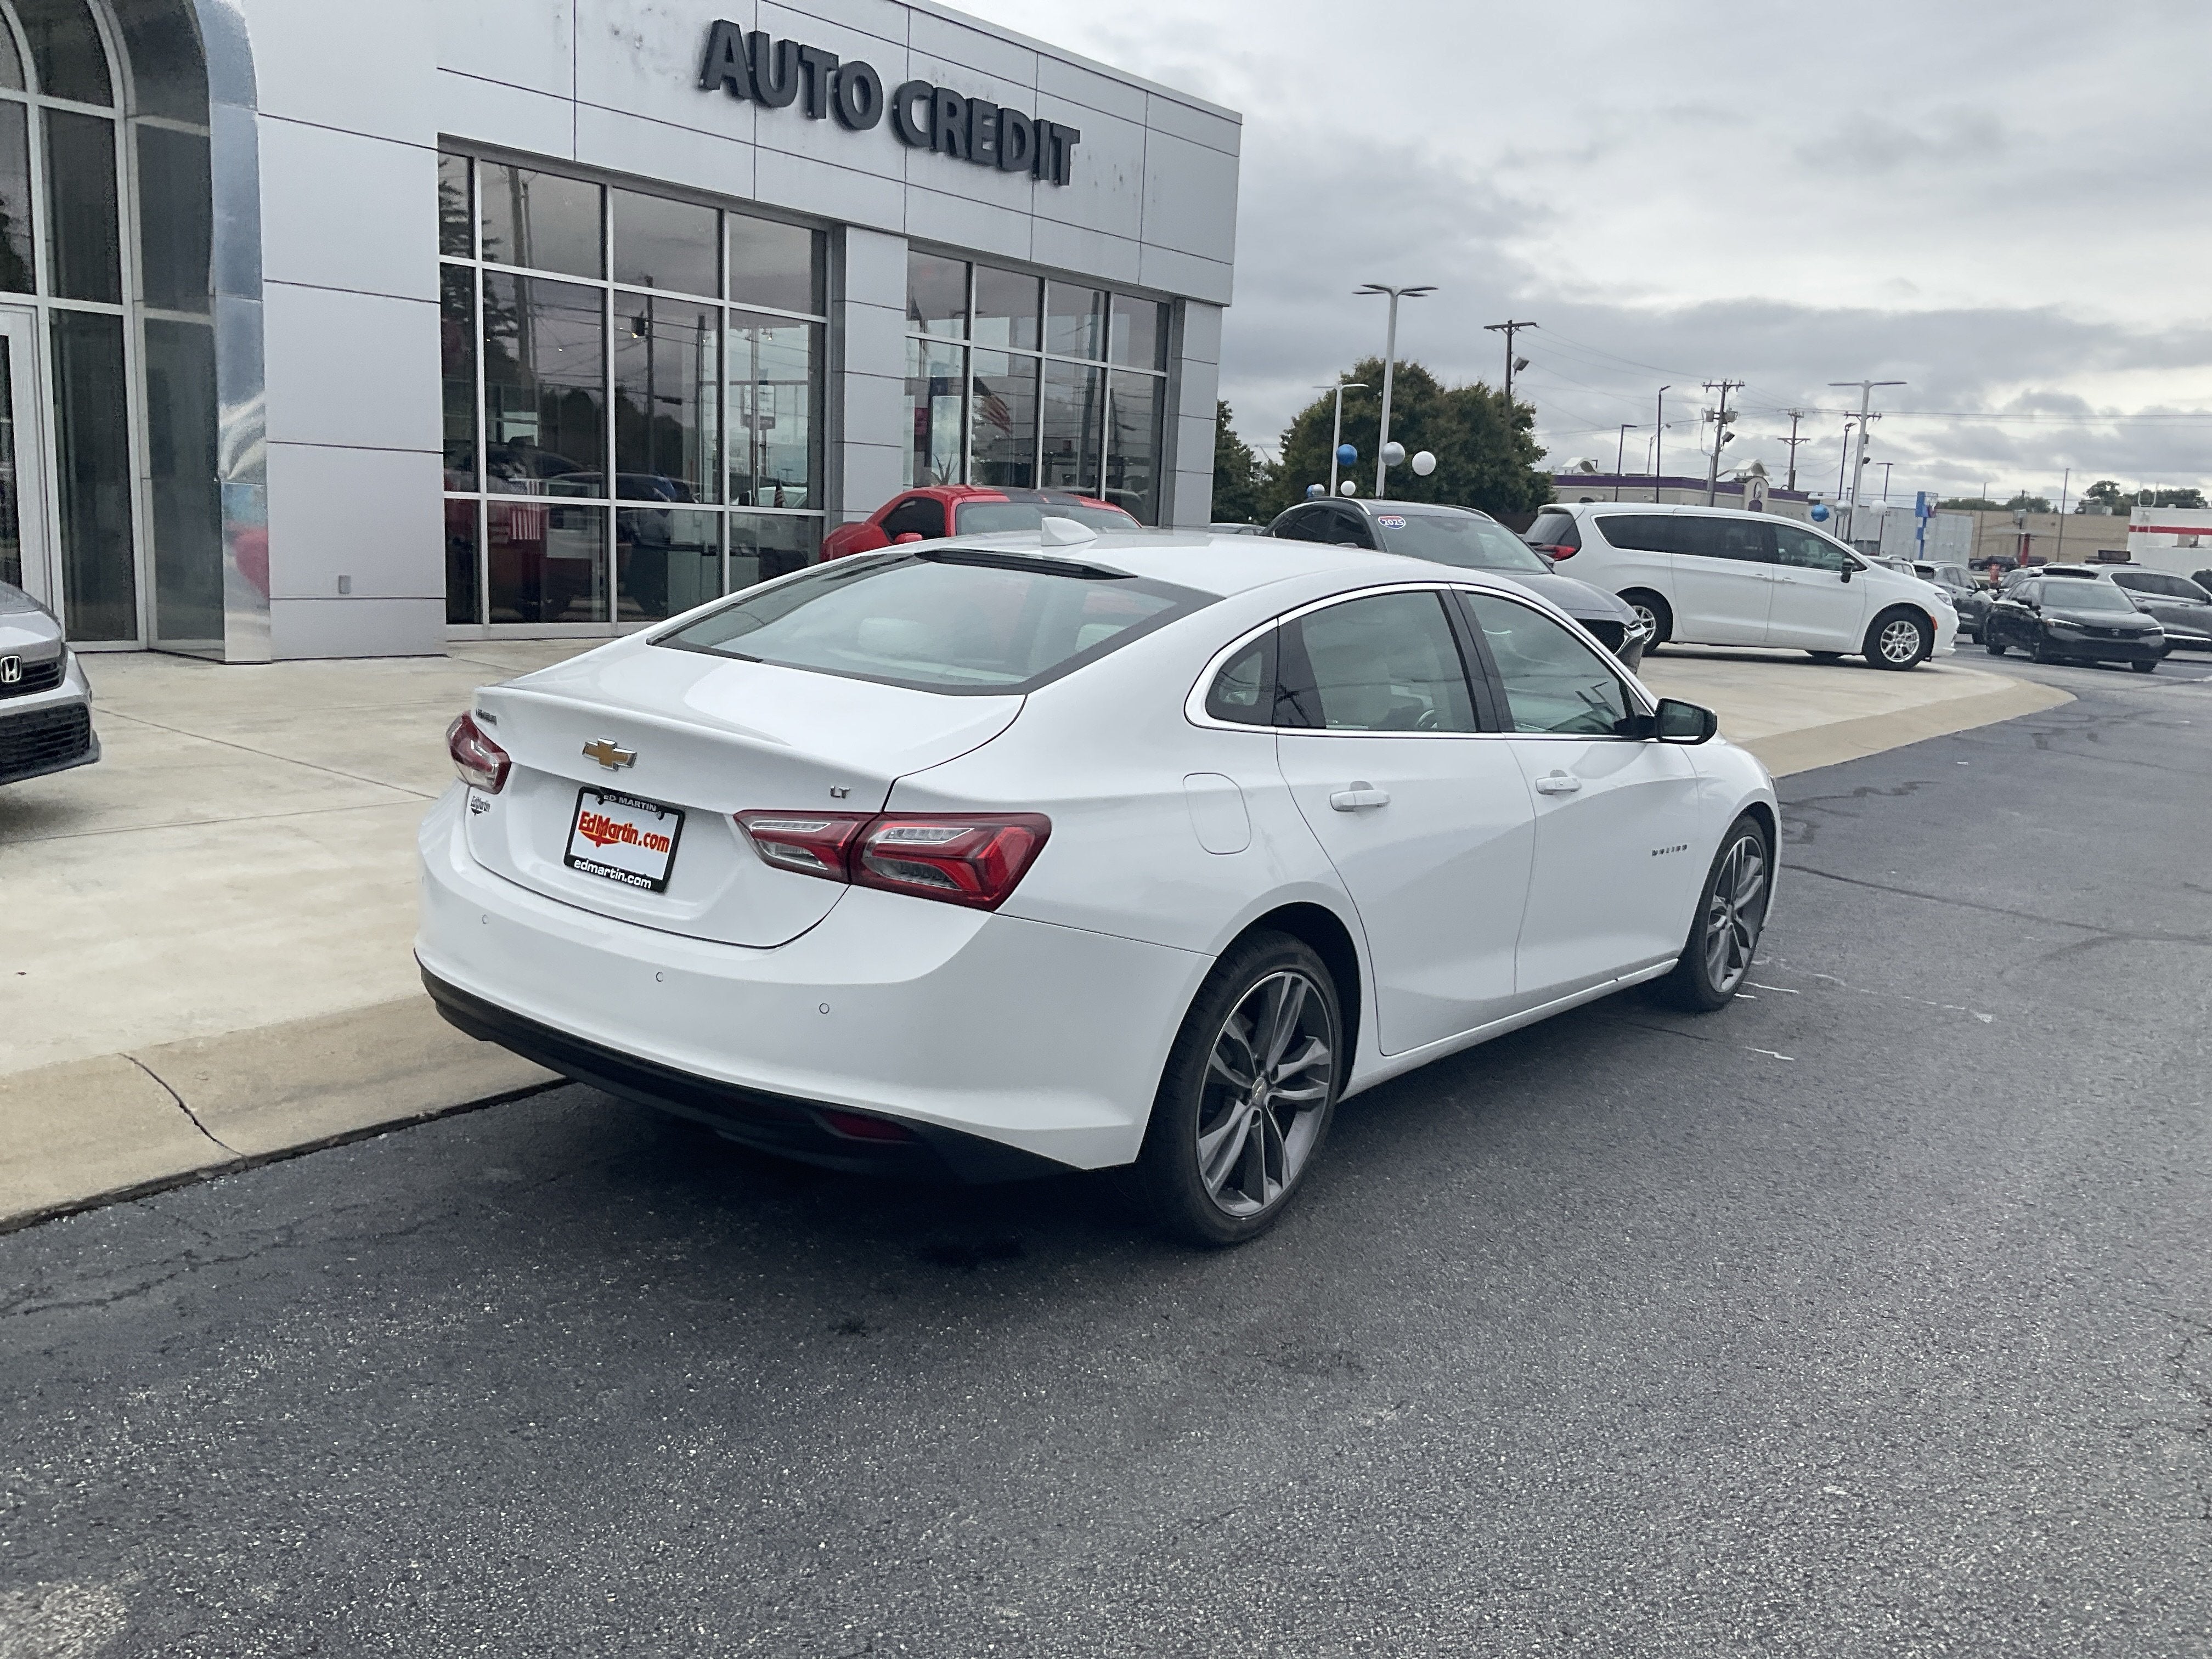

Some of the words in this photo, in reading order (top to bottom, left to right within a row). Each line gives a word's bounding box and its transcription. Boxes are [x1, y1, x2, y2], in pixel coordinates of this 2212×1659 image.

[699, 19, 883, 131] AUTO
[893, 80, 1080, 187] CREDIT
[618, 797, 657, 812] MARTIN
[830, 785, 851, 799] LT
[578, 810, 670, 854] EdMartin.com
[574, 859, 652, 889] edmartin.com
